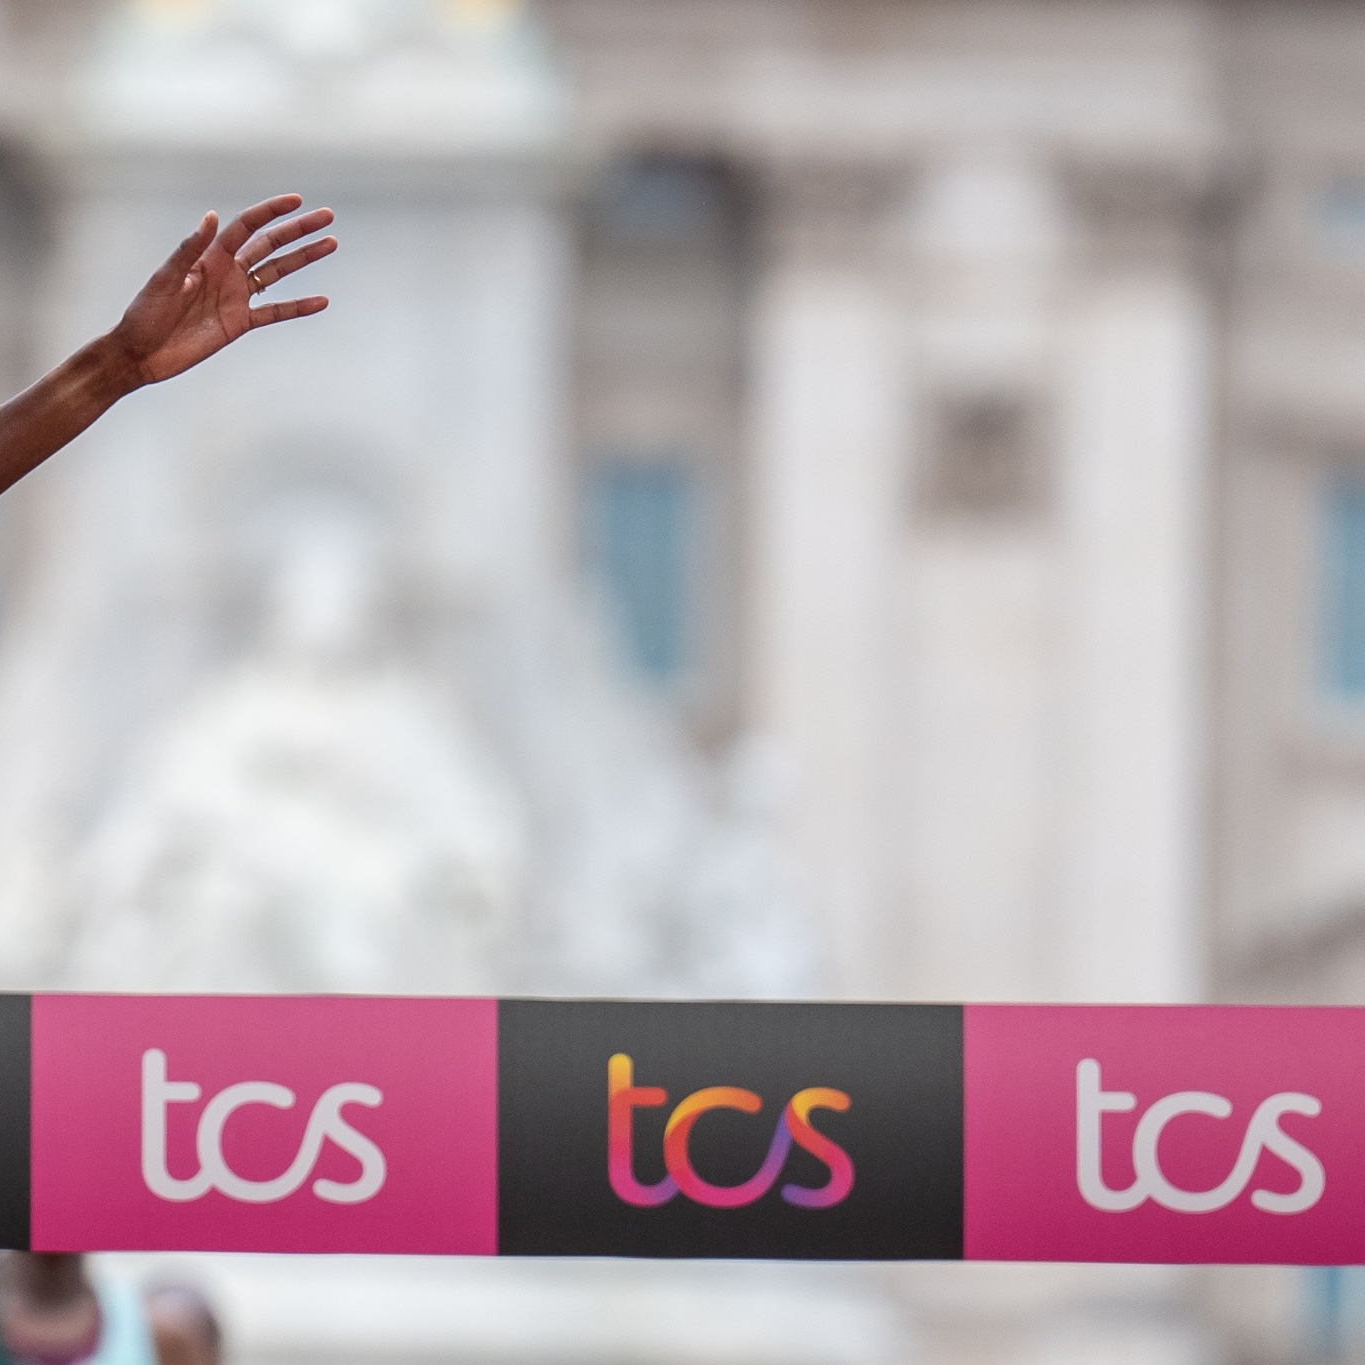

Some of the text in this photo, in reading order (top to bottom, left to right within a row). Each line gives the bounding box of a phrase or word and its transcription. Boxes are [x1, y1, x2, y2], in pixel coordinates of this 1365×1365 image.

[141, 1048, 386, 1203] tcs
[607, 1052, 856, 1210] tcs
[1075, 1057, 1325, 1214] tcs
